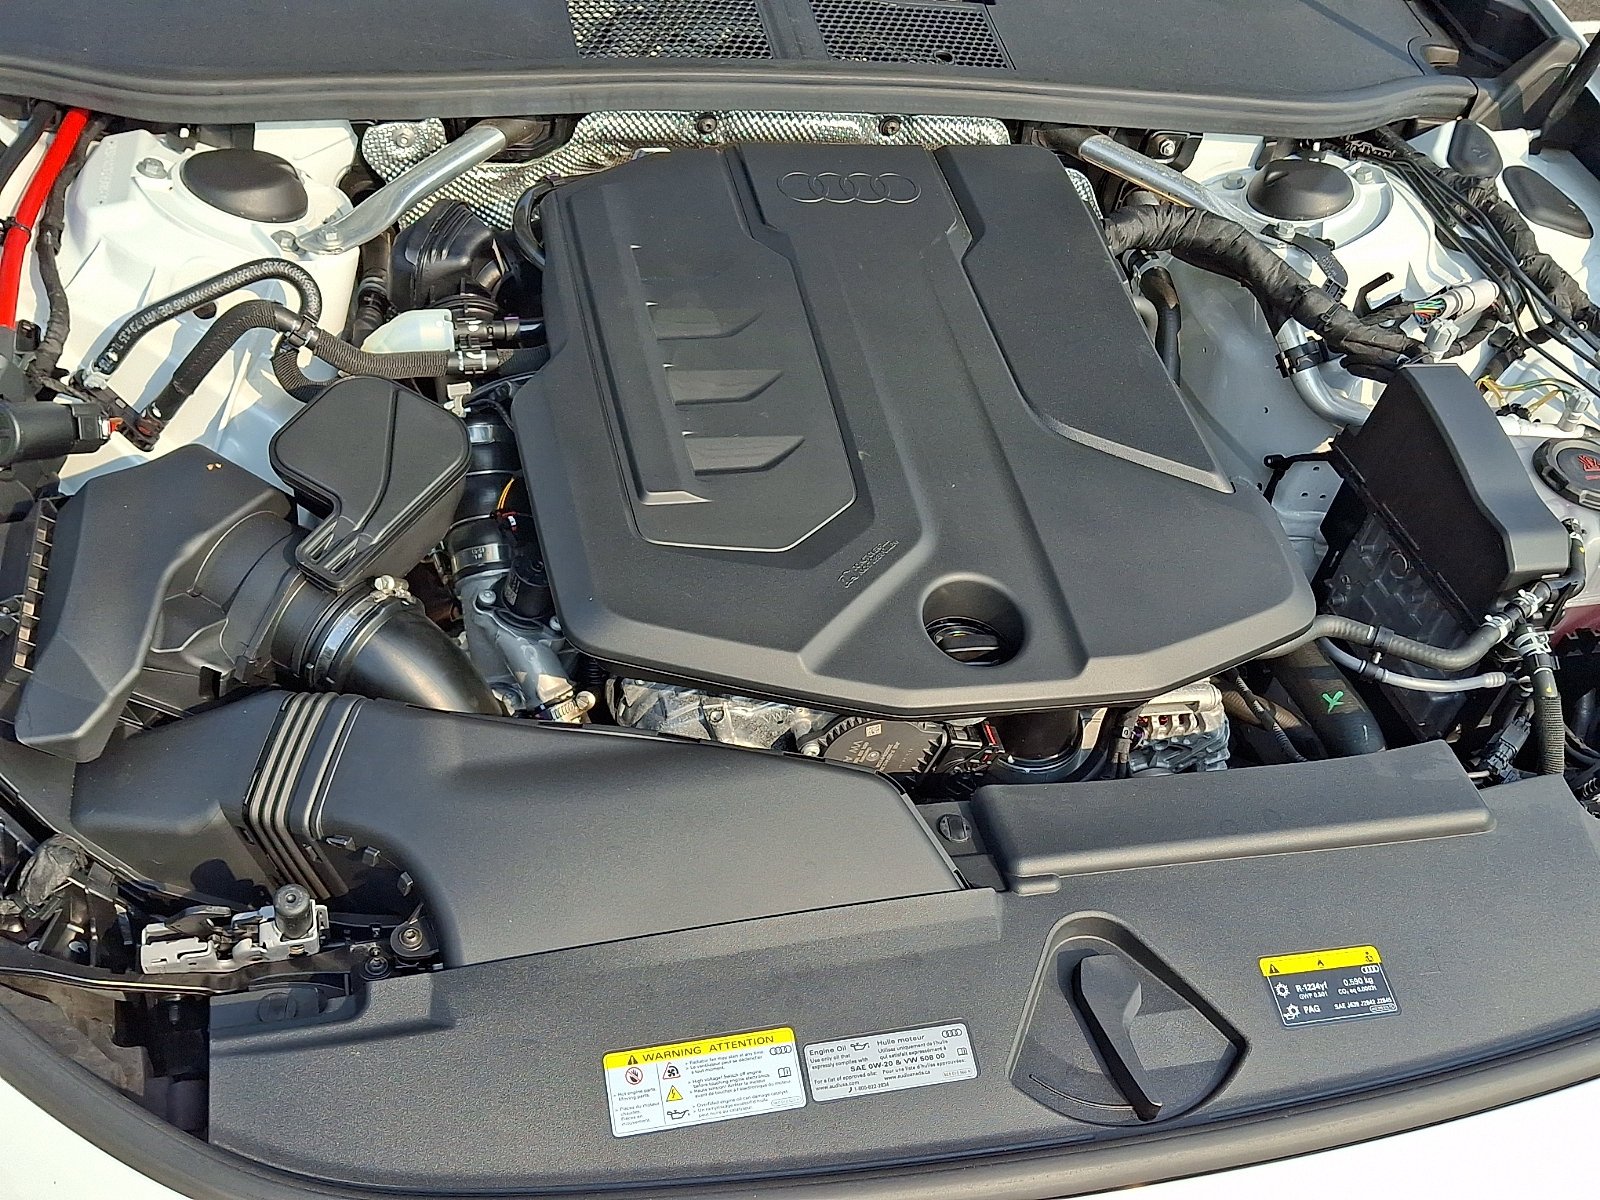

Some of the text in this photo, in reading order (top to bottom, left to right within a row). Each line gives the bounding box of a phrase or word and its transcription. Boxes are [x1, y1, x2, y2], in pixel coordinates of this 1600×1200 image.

[1343, 977, 1363, 986] 0.590
[1303, 1005, 1321, 1013] PAG
[898, 1035, 924, 1043] moteur
[643, 1036, 773, 1061] WARNING ATTENTION
[809, 1048, 834, 1056] Engine
[851, 1064, 866, 1072] SAE
[868, 1061, 893, 1069] 0W-20
